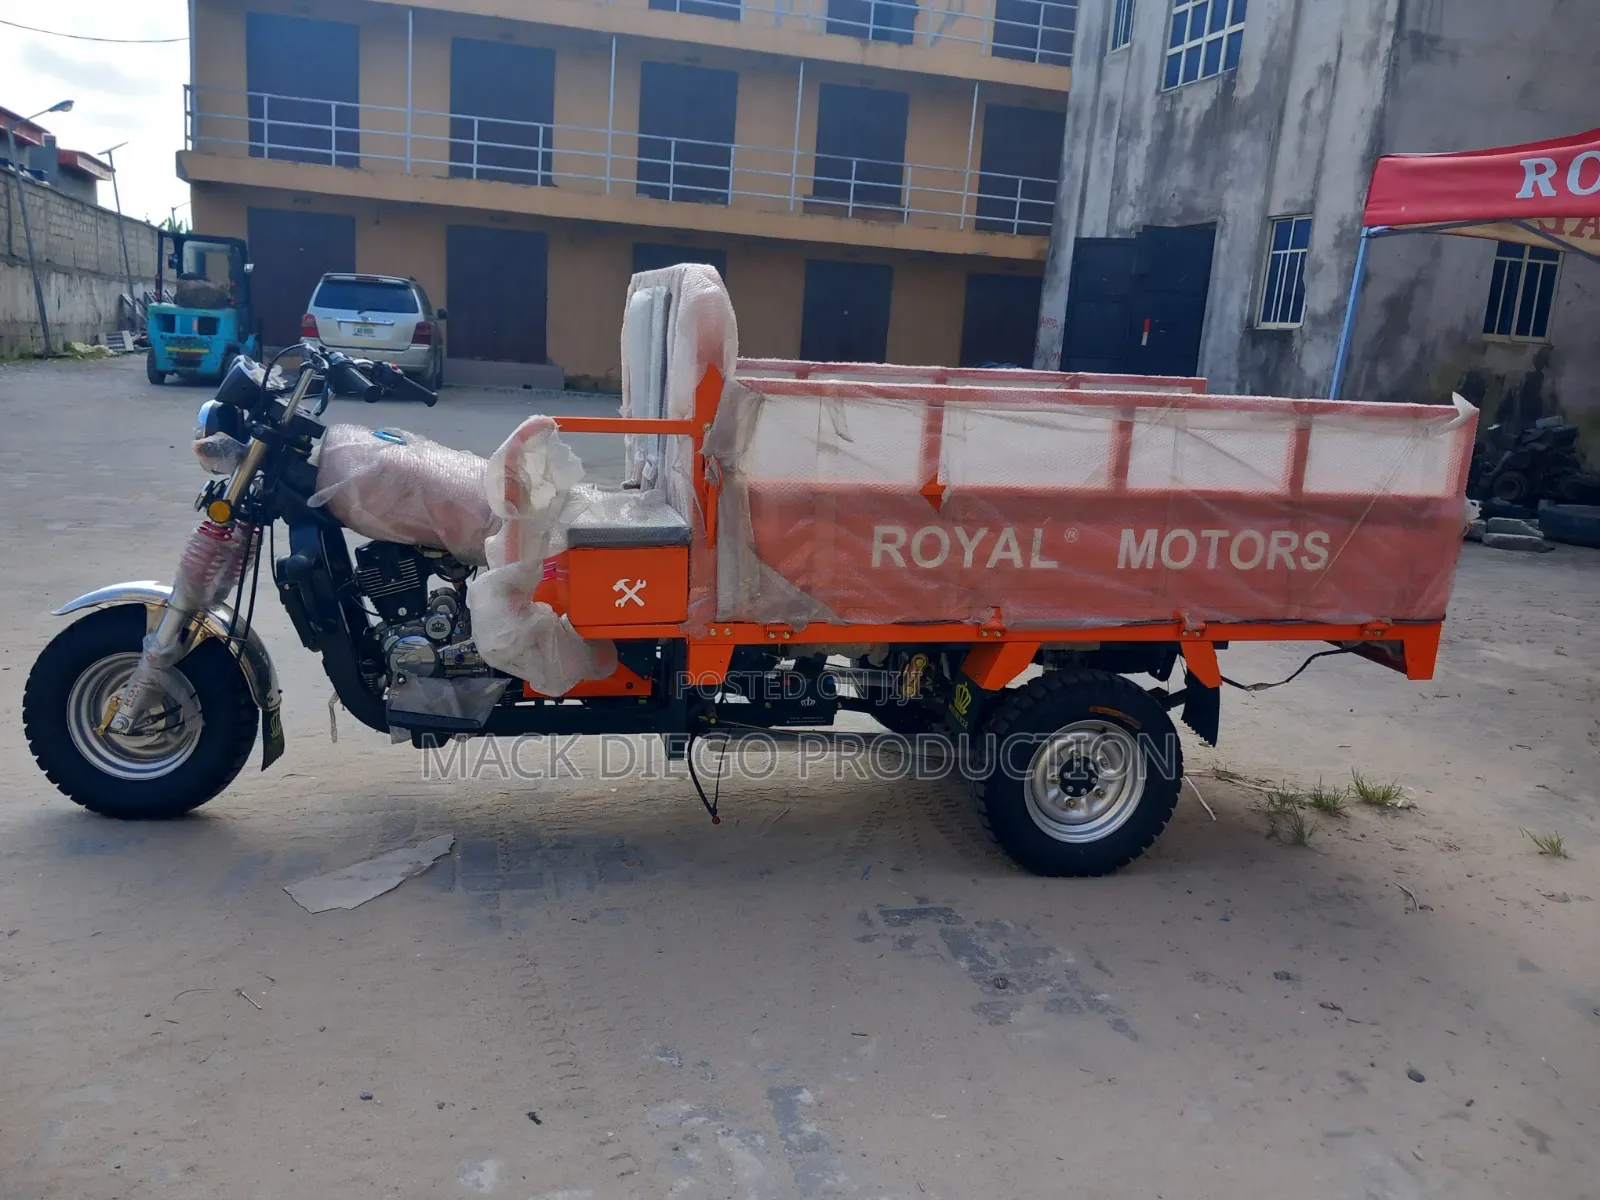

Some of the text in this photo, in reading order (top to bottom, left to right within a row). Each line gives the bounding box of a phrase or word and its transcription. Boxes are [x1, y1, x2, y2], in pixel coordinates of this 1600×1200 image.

[1515, 150, 1600, 198] RO
[871, 526, 1060, 568] ROYAL
[1117, 528, 1330, 571] MOTORS
